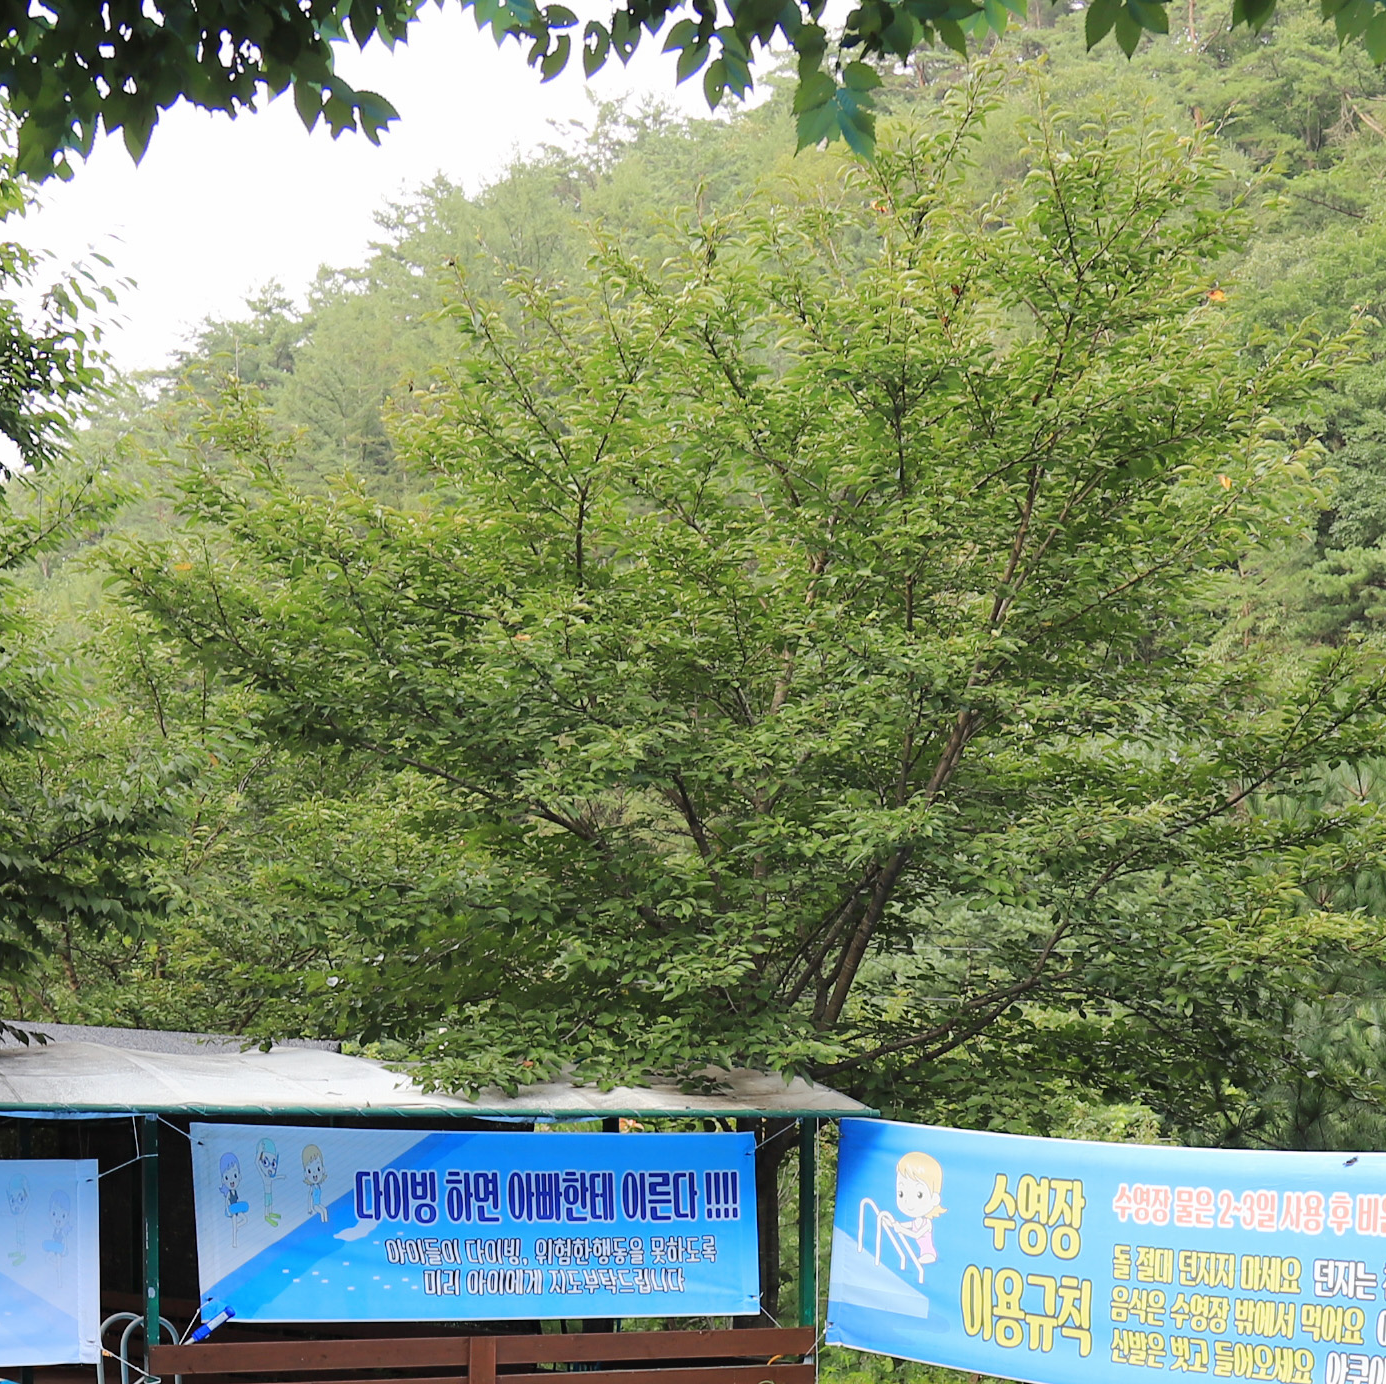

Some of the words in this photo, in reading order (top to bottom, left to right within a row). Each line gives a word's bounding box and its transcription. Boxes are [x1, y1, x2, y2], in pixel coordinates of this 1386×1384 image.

[355, 1171, 437, 1224] 다이빙
[444, 1171, 500, 1222] 하면
[507, 1171, 614, 1222] 아빠한테
[622, 1171, 698, 1221] 이른다
[704, 1171, 739, 1219] !!!!
[983, 1173, 1086, 1260] 수영장
[1114, 1184, 1170, 1223] 수영장
[1175, 1187, 1213, 1226] 물은
[1219, 1190, 1276, 1230] 2~3일
[1281, 1194, 1323, 1234] 사용
[1330, 1195, 1351, 1235] 후
[385, 1238, 462, 1266] 아이들이
[465, 1238, 528, 1266] 다이빙,
[534, 1237, 643, 1266] 위험한행동을
[650, 1235, 717, 1264] 못하도록
[1113, 1244, 1132, 1281] 돌
[1135, 1246, 1174, 1284] 절대
[1178, 1250, 1236, 1289] 던지지
[1241, 1253, 1302, 1294] 마세요
[1313, 1258, 1377, 1301] 던지는
[423, 1269, 460, 1296] 미리
[466, 1268, 543, 1296] 아이에게
[549, 1267, 685, 1295] 지도부탁드립니다
[961, 1265, 1092, 1357] 이용규칙
[1110, 1285, 1166, 1327] 음식은
[1170, 1292, 1229, 1335] 수영장
[1234, 1298, 1296, 1339] 밖에서
[1301, 1303, 1365, 1346] 먹어요
[1110, 1328, 1166, 1369] 신발은
[1169, 1336, 1209, 1374] 벗고
